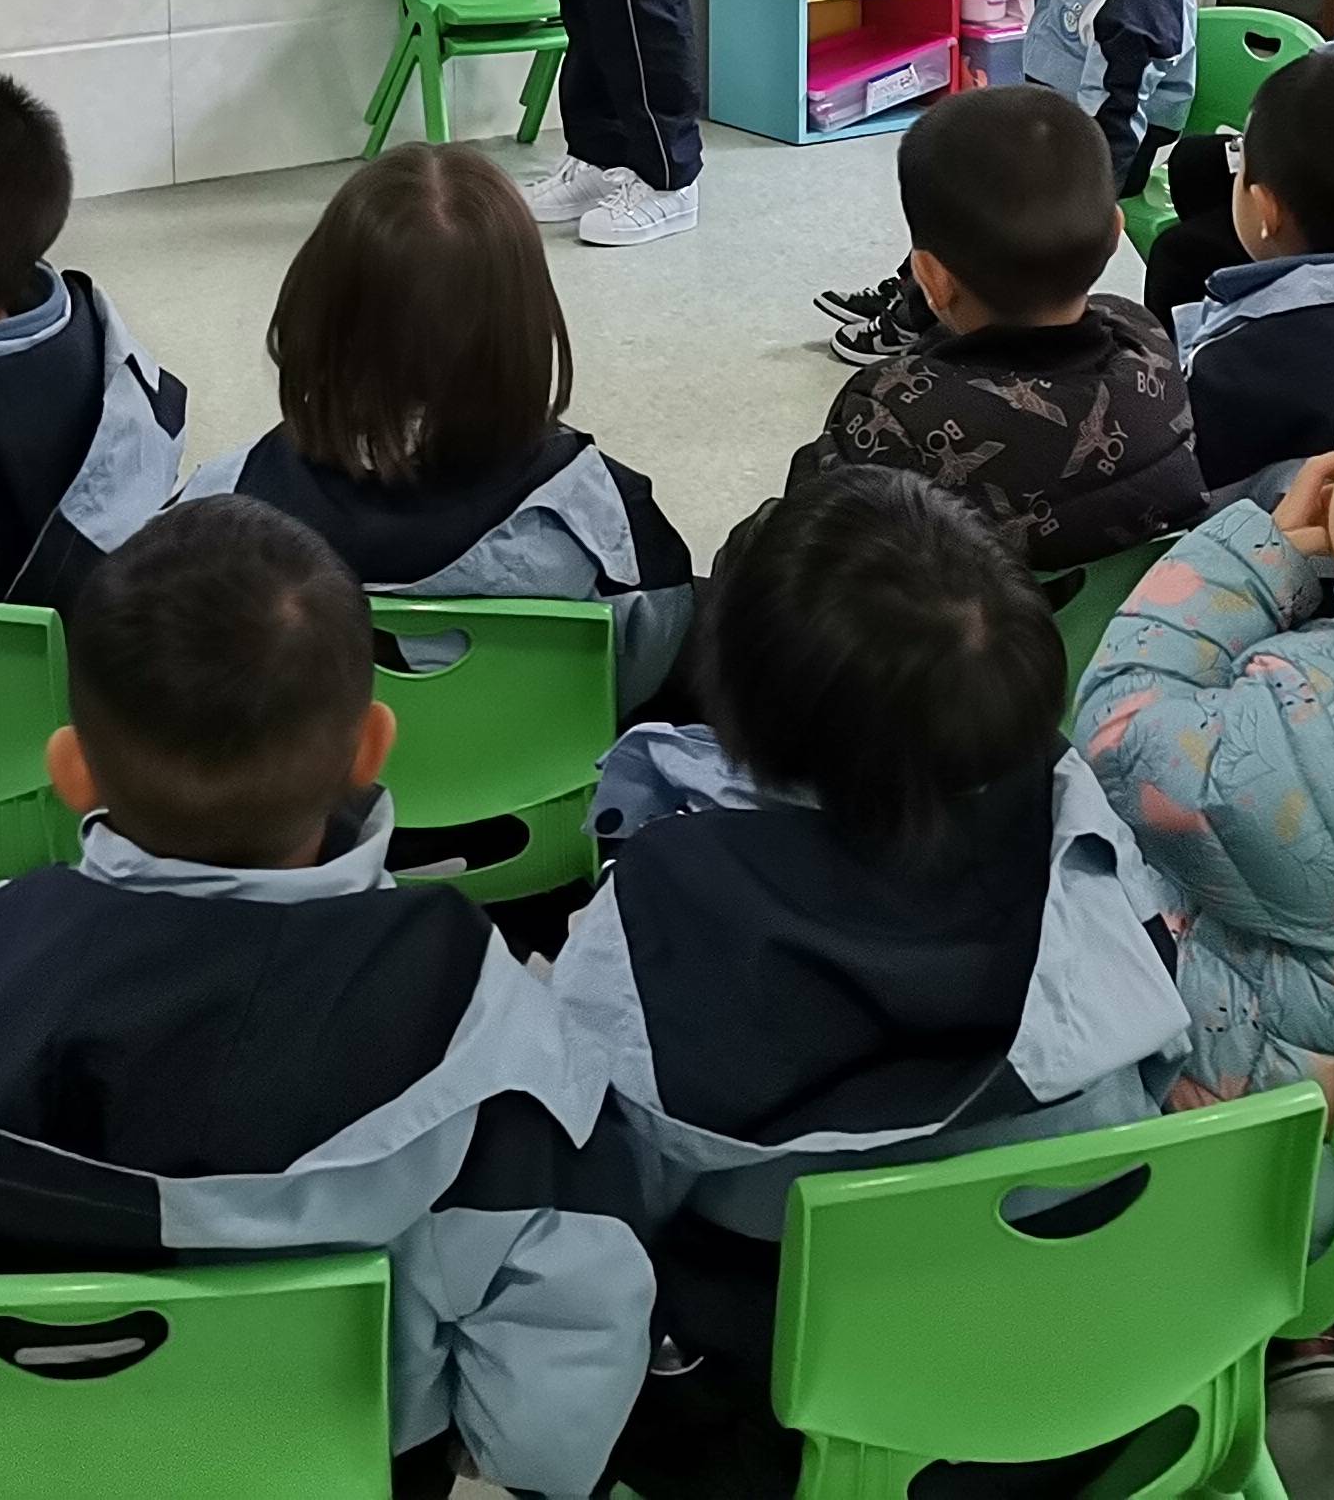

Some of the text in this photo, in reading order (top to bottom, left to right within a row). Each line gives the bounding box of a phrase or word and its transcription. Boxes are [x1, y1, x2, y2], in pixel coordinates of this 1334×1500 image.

[1137, 370, 1167, 401] BOY
[845, 413, 889, 459] BOY
[915, 418, 965, 466] BOY
[1096, 420, 1130, 477] BOY
[1021, 489, 1060, 537] BOY
